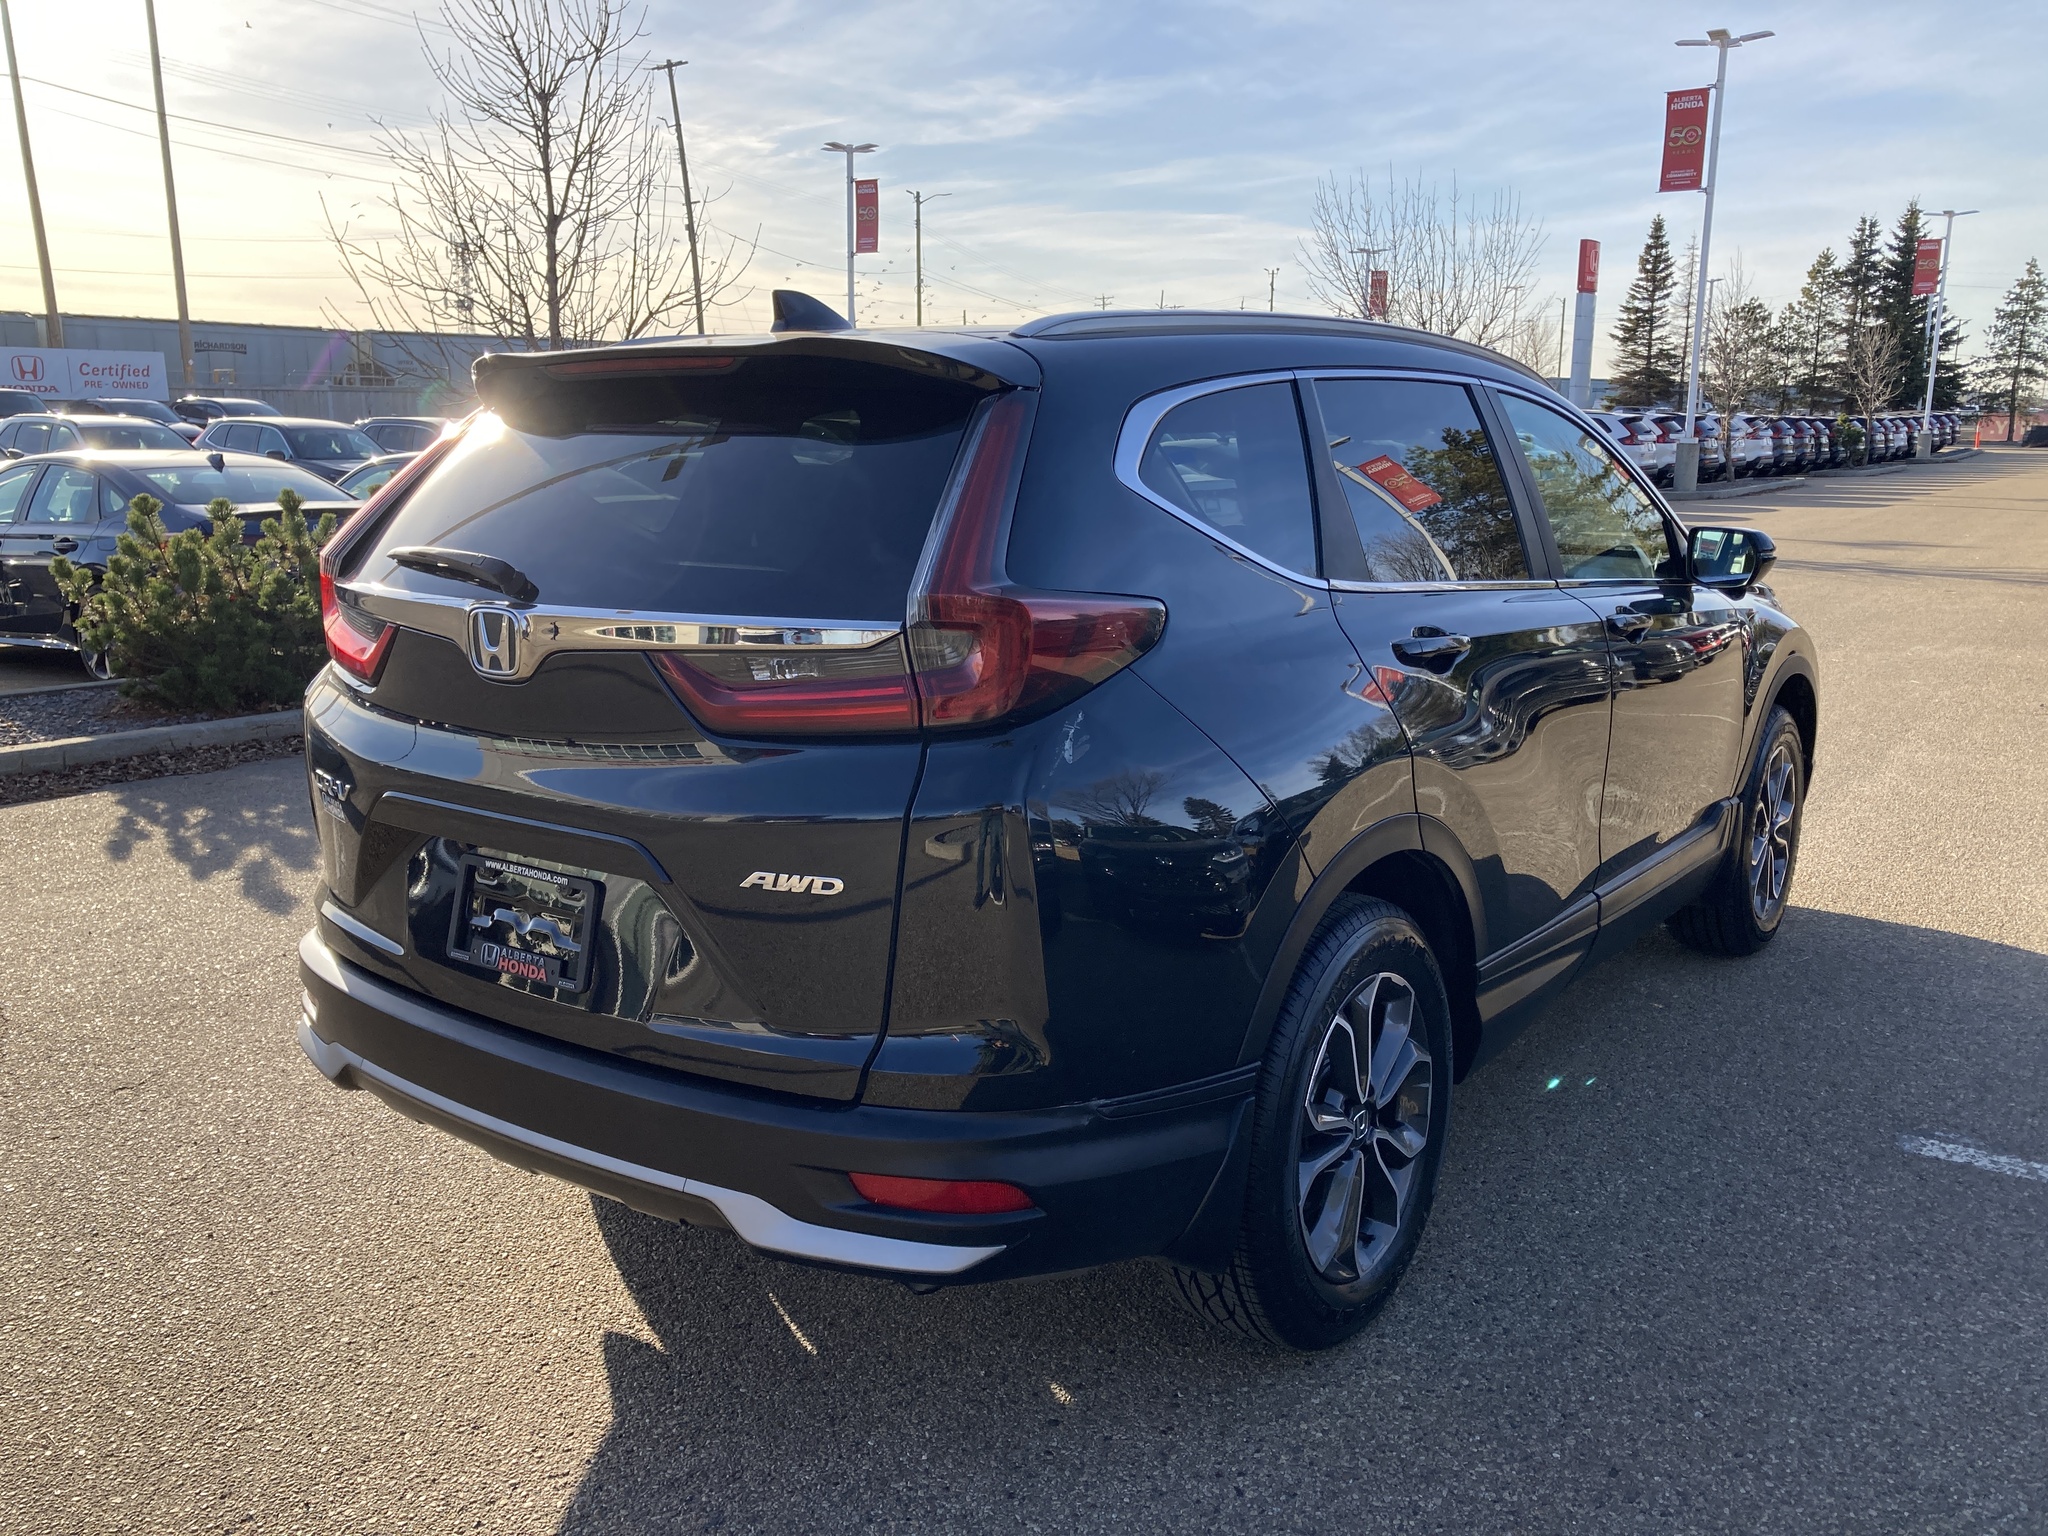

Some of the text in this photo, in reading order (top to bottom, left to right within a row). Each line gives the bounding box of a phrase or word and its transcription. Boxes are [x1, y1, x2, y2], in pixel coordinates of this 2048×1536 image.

[1670, 100, 1704, 110] HONDA
[1673, 95, 1702, 103] ALBERTA
[1668, 125, 1702, 147] 50
[194, 340, 247, 350] RICHARDSON
[79, 362, 150, 380] Certified
[485, 860, 569, 886] www.ALBERTAHONDA.com
[740, 871, 844, 895] AWD
[501, 948, 545, 966] ALBERTA
[498, 957, 547, 981] HONDA
